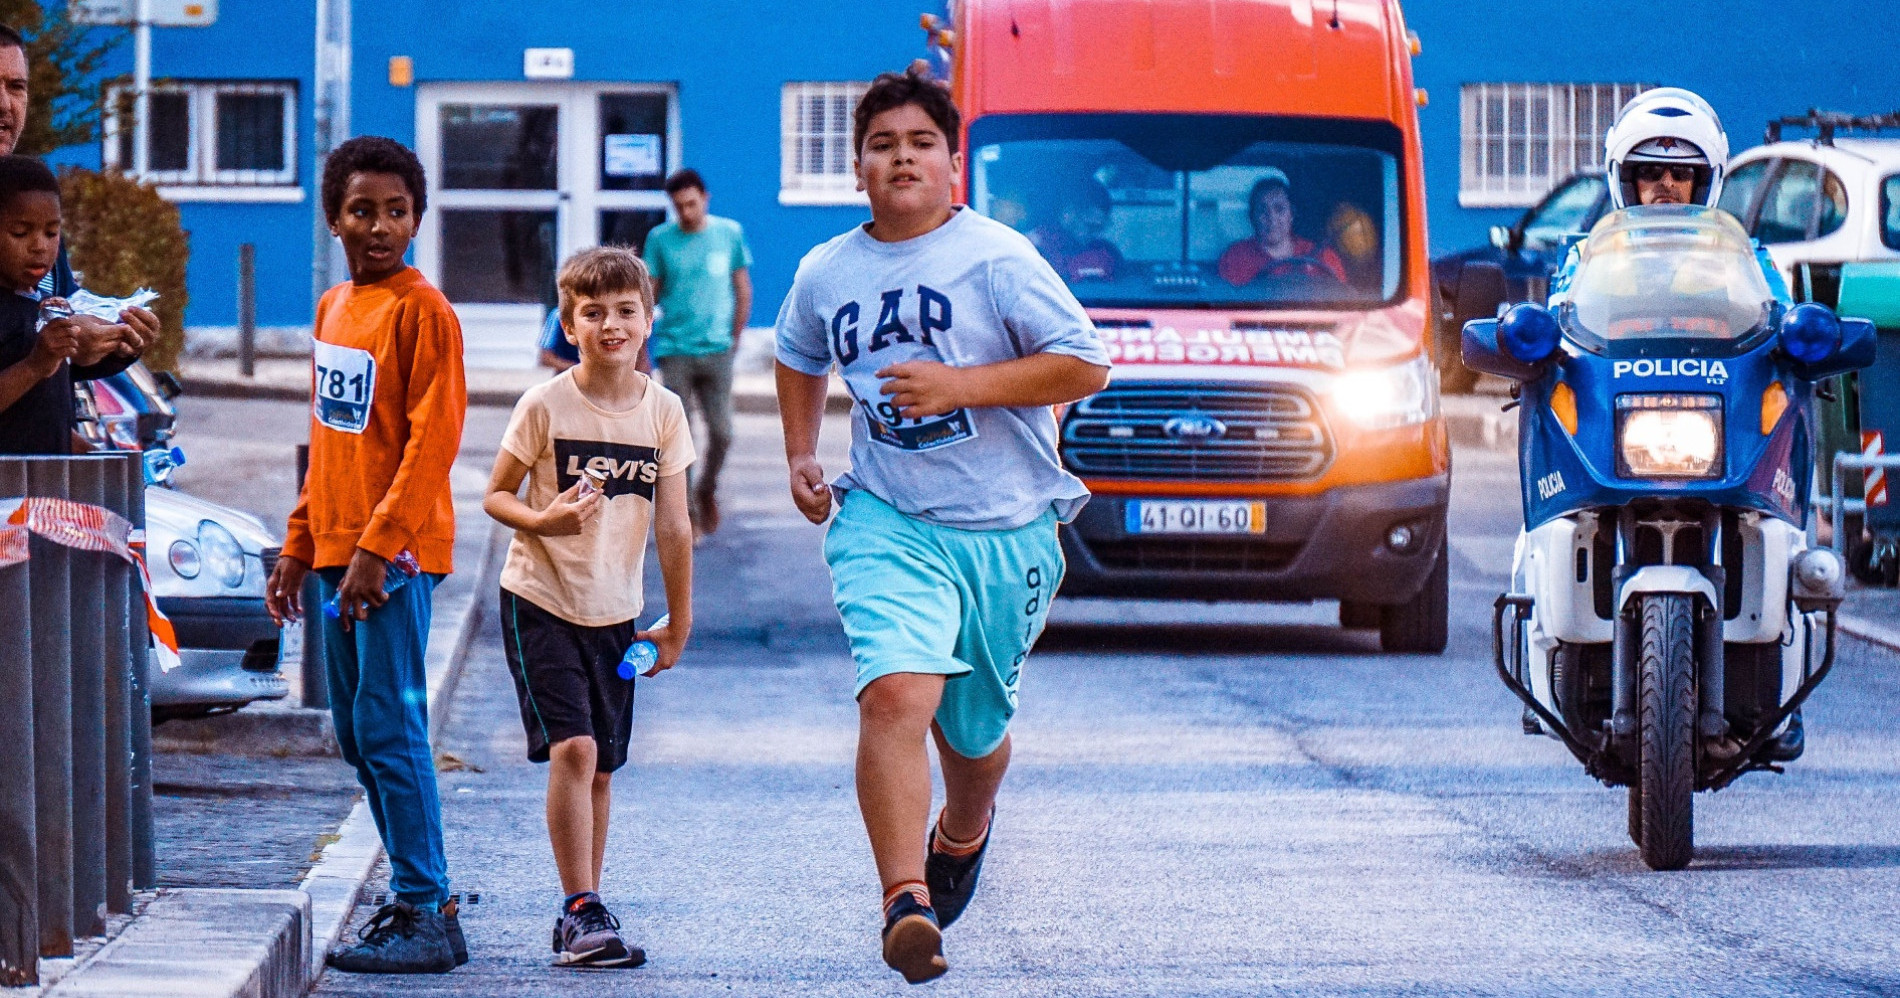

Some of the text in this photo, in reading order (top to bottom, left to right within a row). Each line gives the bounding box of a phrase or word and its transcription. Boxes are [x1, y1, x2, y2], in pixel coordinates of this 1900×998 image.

[832, 284, 952, 366] GAP
[317, 364, 364, 401] 781
[1613, 359, 1729, 379] POLICIA
